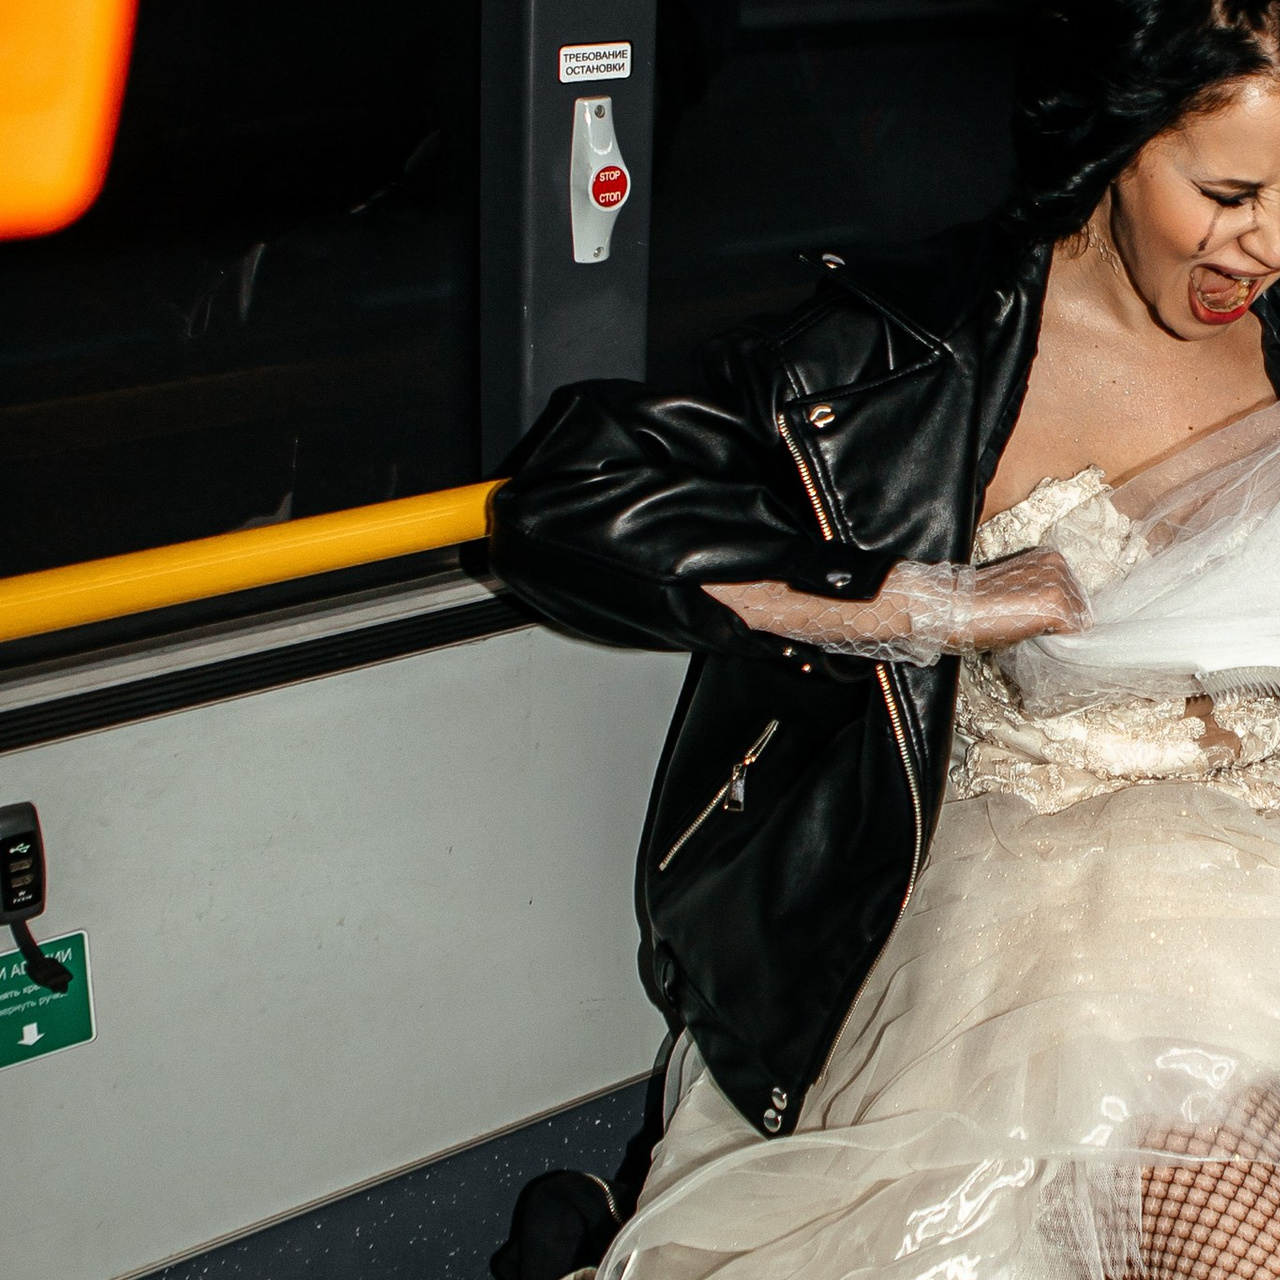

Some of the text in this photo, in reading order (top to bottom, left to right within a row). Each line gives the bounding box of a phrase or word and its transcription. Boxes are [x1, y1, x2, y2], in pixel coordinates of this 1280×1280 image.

[563, 49, 628, 63] ТРЕБОВАНИЕ
[565, 62, 625, 76] ОСТАНОВКИ
[599, 170, 621, 182] STOP
[599, 191, 621, 203] СТОП
